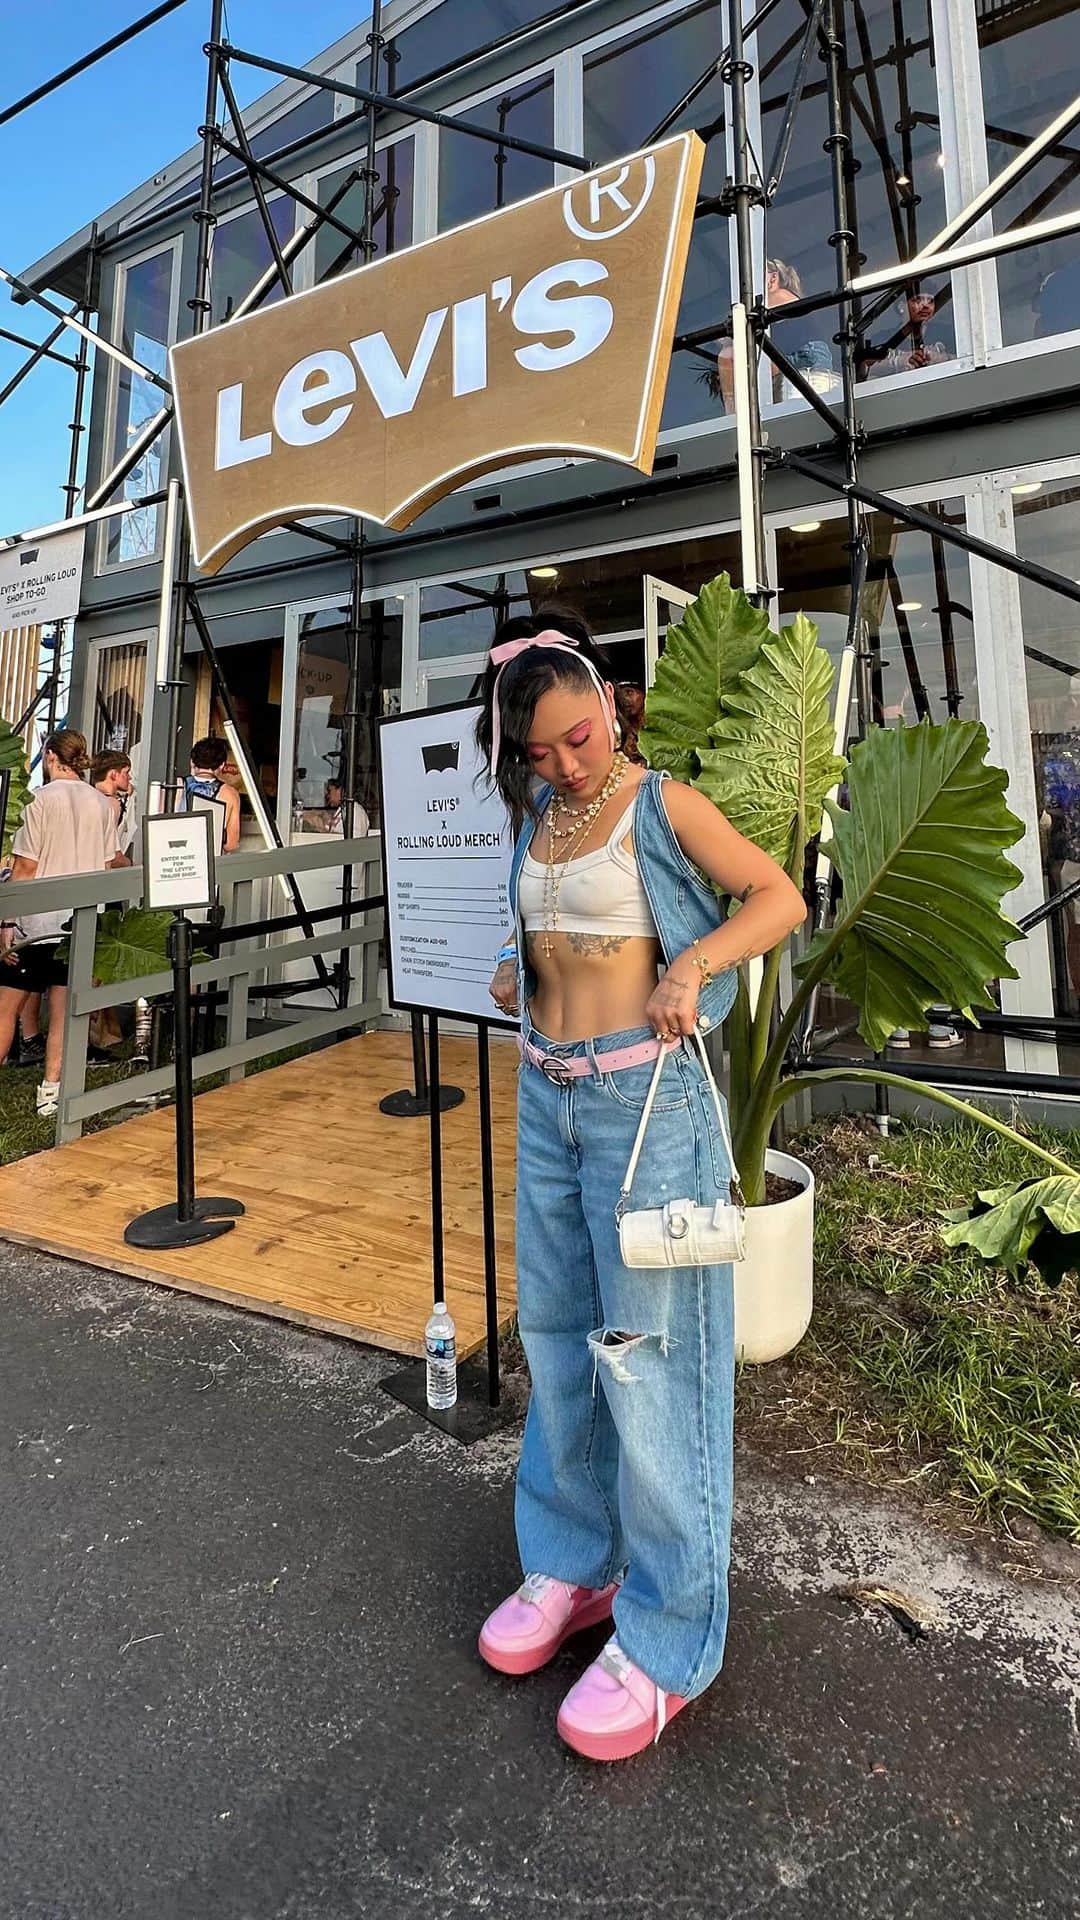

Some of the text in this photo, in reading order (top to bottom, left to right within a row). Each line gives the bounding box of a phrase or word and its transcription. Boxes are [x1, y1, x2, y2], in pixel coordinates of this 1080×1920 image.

[27, 573, 56, 586] ROLLING
[57, 567, 77, 580] LOUD
[6, 587, 46, 604] SHOP TO-GO
[397, 833, 500, 848] ROLLING LOUD MERCH
